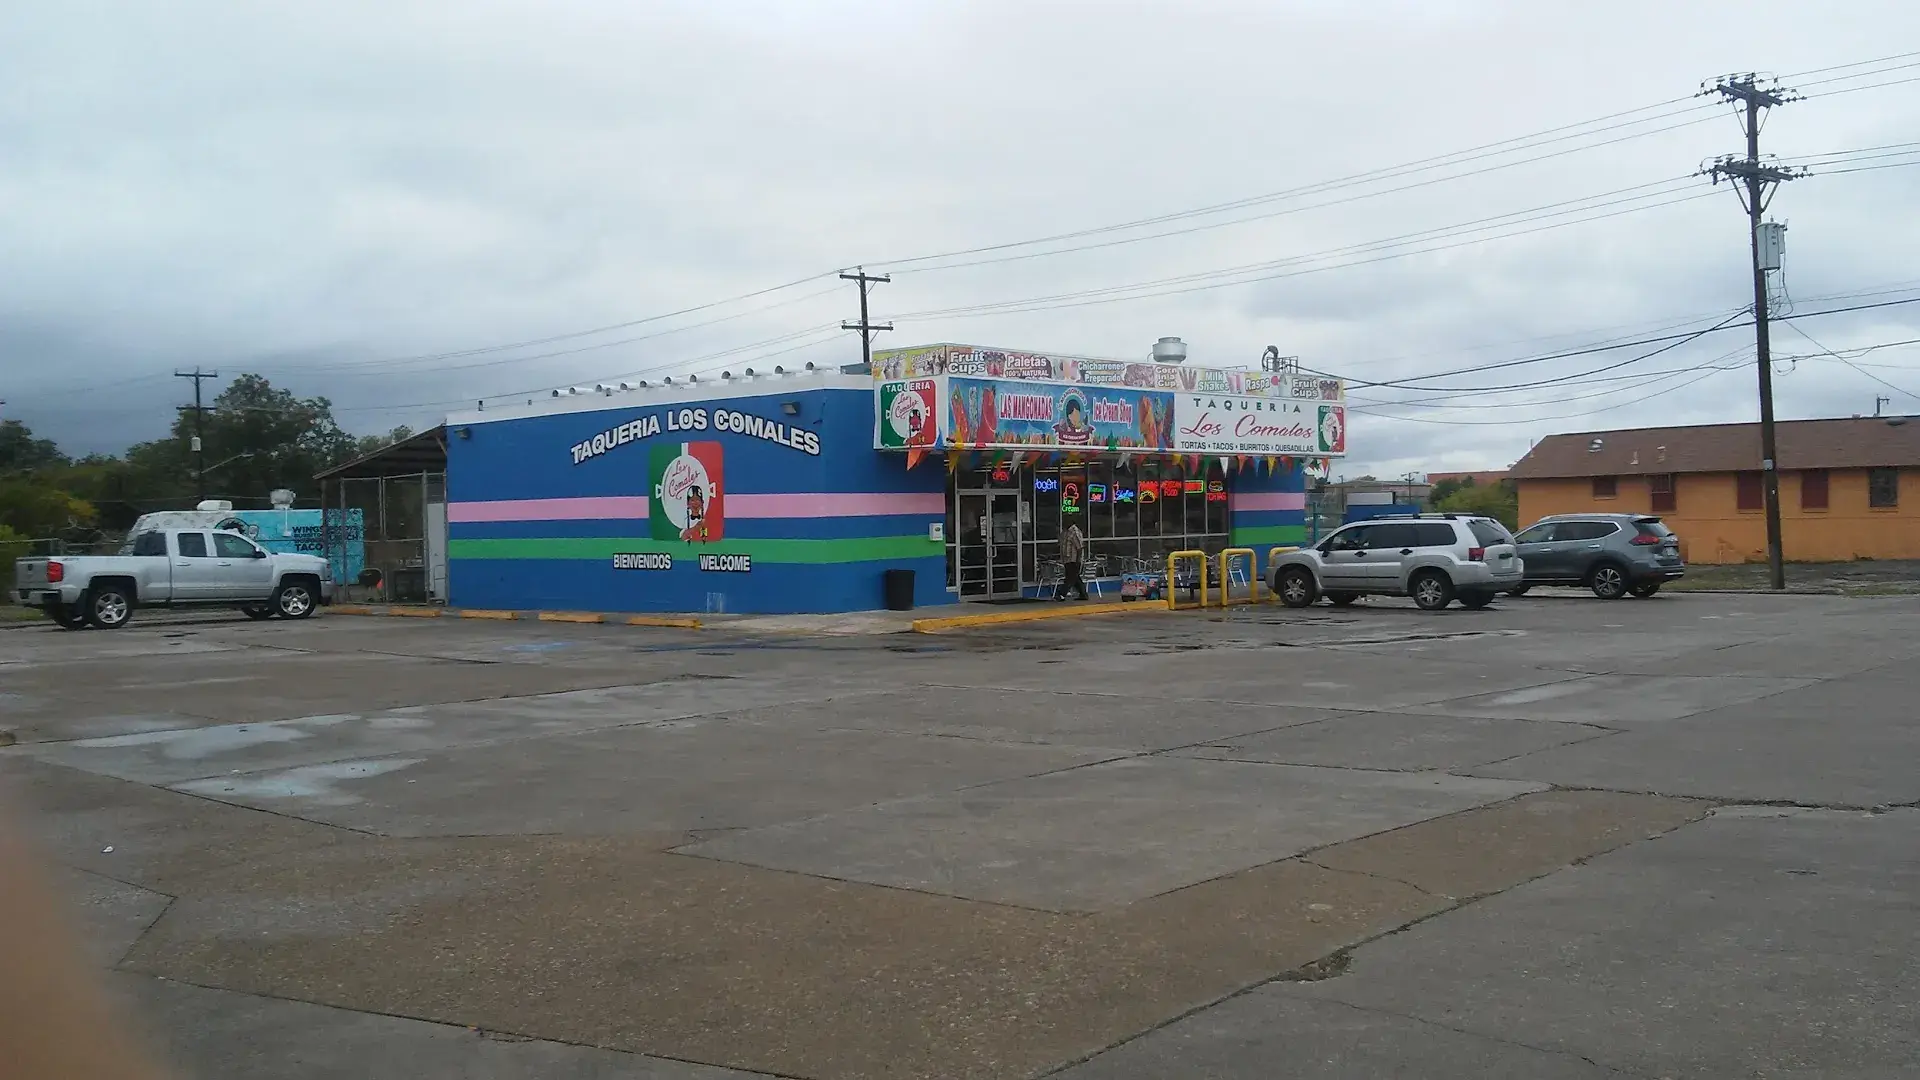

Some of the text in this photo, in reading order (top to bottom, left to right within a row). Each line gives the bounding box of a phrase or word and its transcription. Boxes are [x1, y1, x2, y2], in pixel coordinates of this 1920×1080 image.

[950, 350, 985, 363] Fruit
[1007, 355, 1047, 368] Paletas
[948, 362, 985, 375] Cups
[1022, 369, 1049, 377] NATURAL
[1155, 366, 1177, 374] Corn
[1205, 371, 1224, 381] Milk
[886, 381, 931, 393] TAQUERIA
[1157, 379, 1177, 388] Cup
[1197, 380, 1230, 392] Shakes
[1292, 378, 1318, 389] Fruit
[1292, 388, 1318, 398] Cups
[1000, 392, 1053, 422] LAS MANGONADAS
[1093, 396, 1133, 428] Ice Cream Shop
[1193, 398, 1301, 414] TAQUERIA
[1180, 412, 1225, 437] Los
[1235, 414, 1315, 438] Comales
[570, 408, 821, 465] TAQUERIA LOS COMALES
[1180, 440, 1314, 453] TORTAS TACOS BURRITOS QUESADILLAS
[668, 467, 700, 499] Comales
[1061, 505, 1080, 513] Cream
[613, 553, 672, 570] BIENVENIDOS
[699, 554, 752, 572] WELCOME
